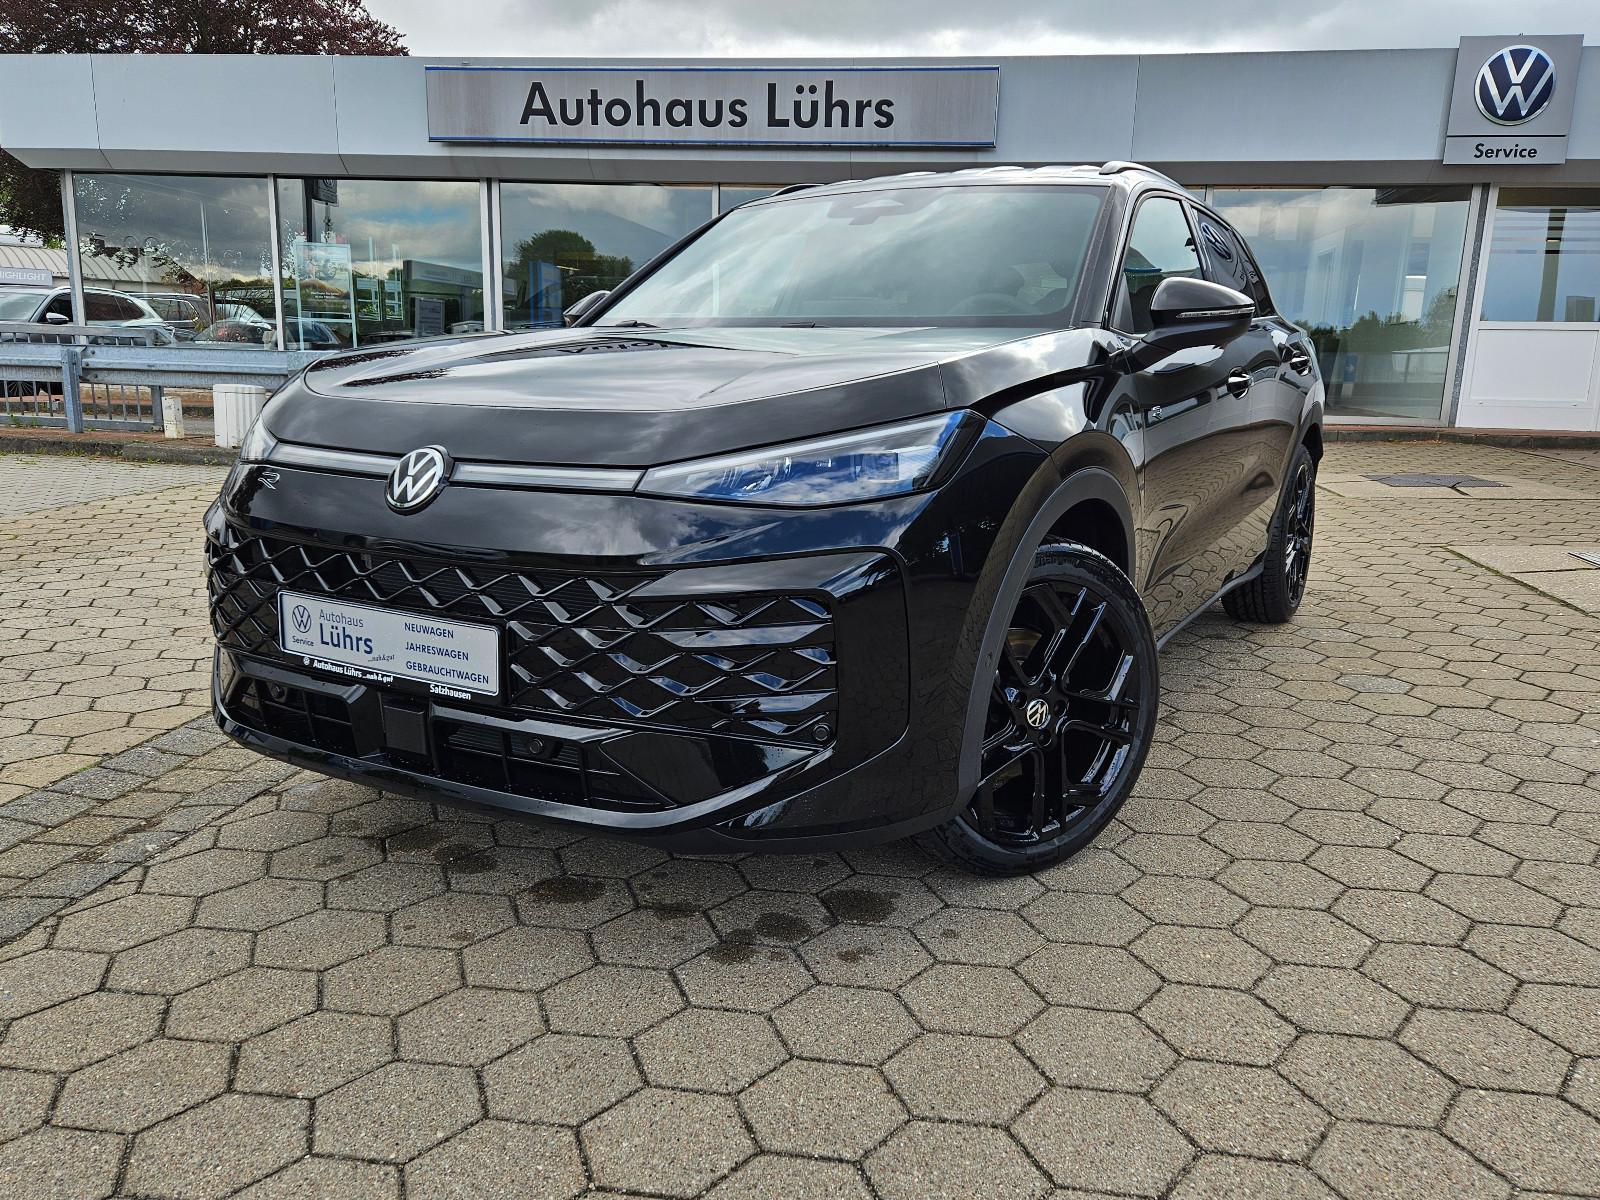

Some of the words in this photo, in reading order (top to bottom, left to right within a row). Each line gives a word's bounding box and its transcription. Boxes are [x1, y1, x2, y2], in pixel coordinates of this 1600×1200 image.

[1475, 45, 1556, 125] VW
[519, 79, 748, 127] Autohaus
[767, 79, 895, 129] Lührs
[1473, 143, 1538, 158] Service
[0, 271, 48, 281] IGHLIGHT
[386, 446, 446, 509] VW
[319, 609, 364, 627] Autohaus
[320, 622, 373, 655] Lührs
[404, 622, 454, 639] NEUWAGEN
[292, 635, 314, 647] Service
[405, 641, 469, 661] JAHRESWAGEN
[313, 660, 343, 674] Autohaus
[344, 666, 362, 677] Lührs
[406, 660, 489, 684] GEBRAUCHTWAGEN
[430, 684, 471, 700] Salzhausen
